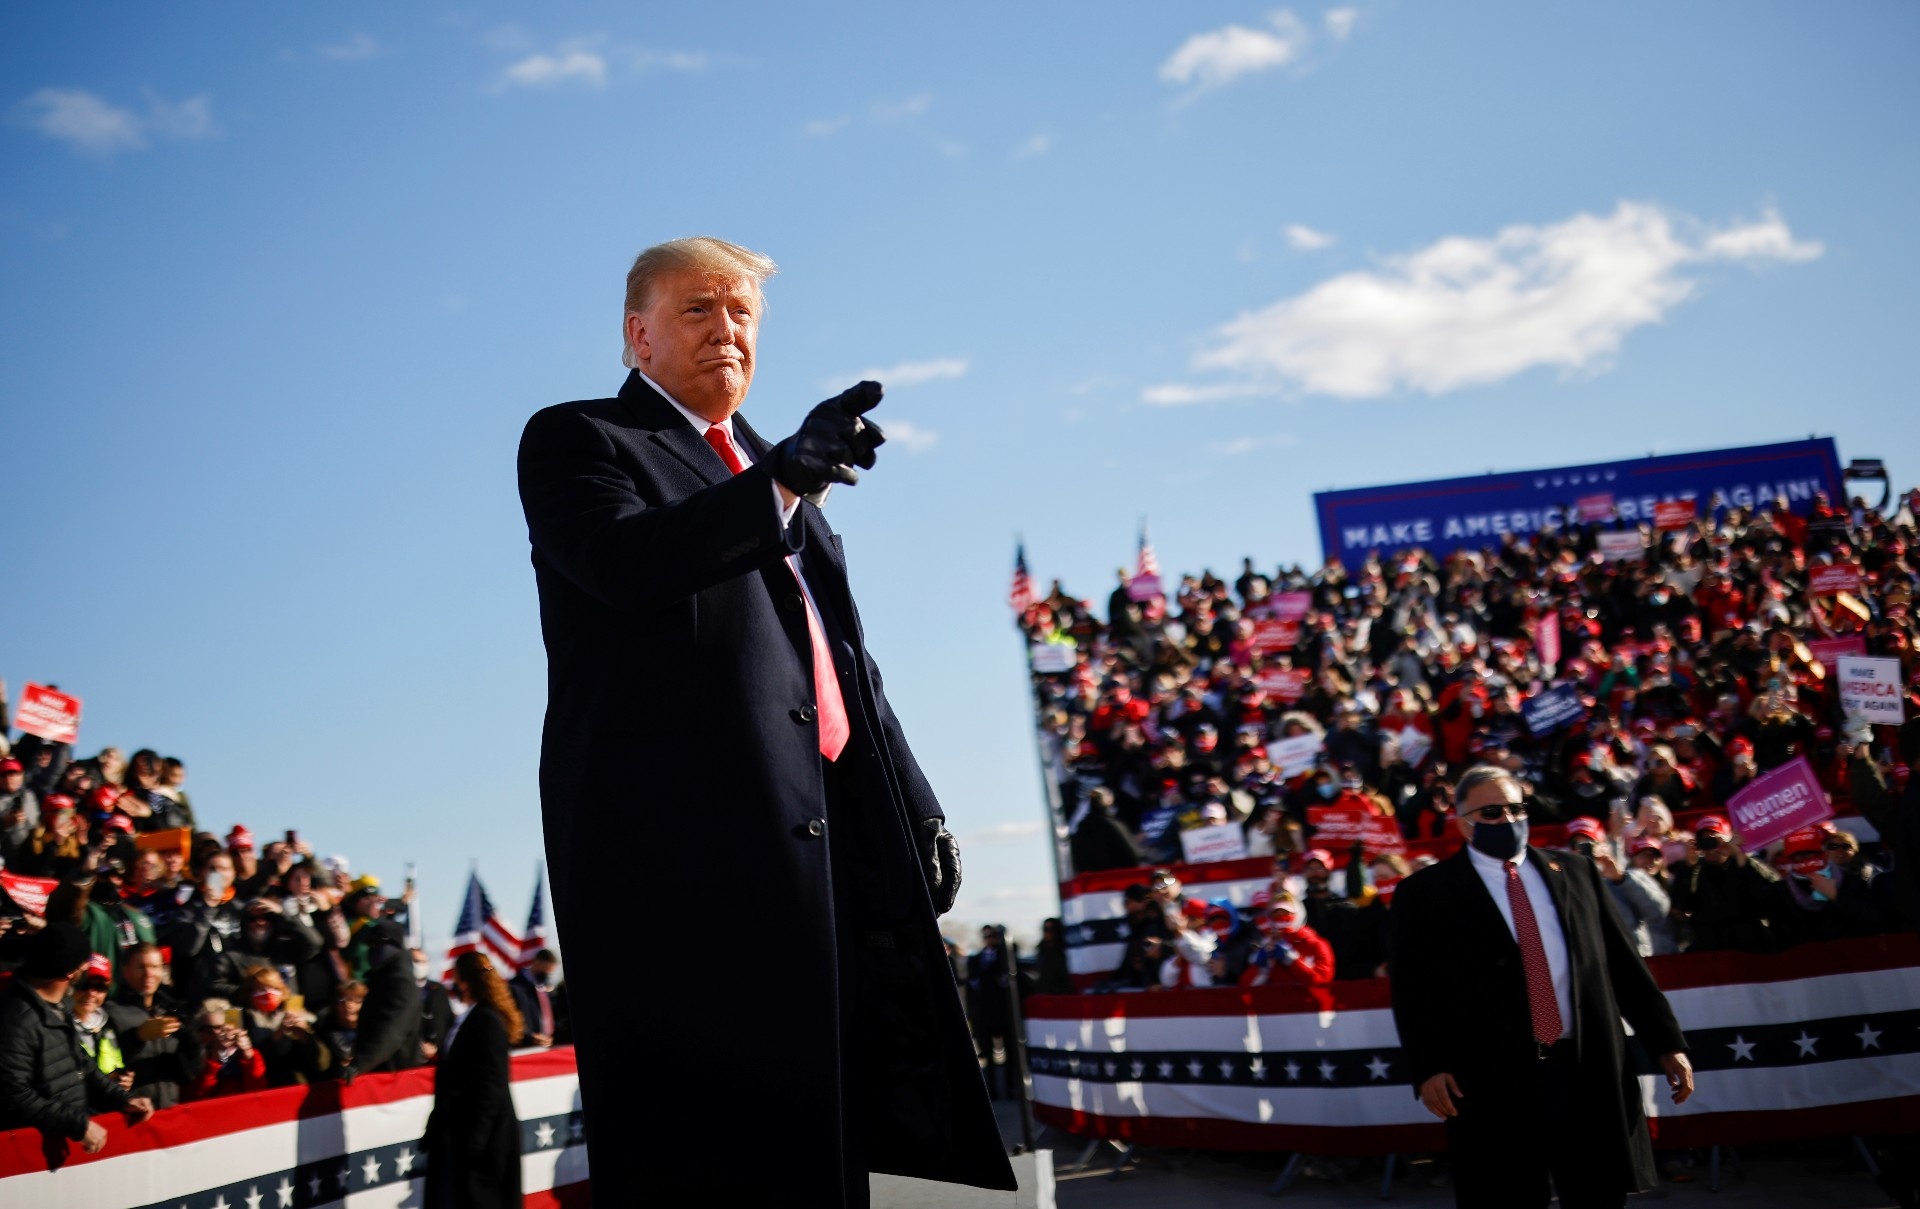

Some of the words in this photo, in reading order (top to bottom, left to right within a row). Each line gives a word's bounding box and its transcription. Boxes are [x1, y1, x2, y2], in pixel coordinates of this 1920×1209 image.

[1344, 520, 1433, 550] MAKE
[1850, 668, 1875, 679] MAKE
[1841, 680, 1898, 698] MERICA
[1736, 784, 1808, 824] Women
